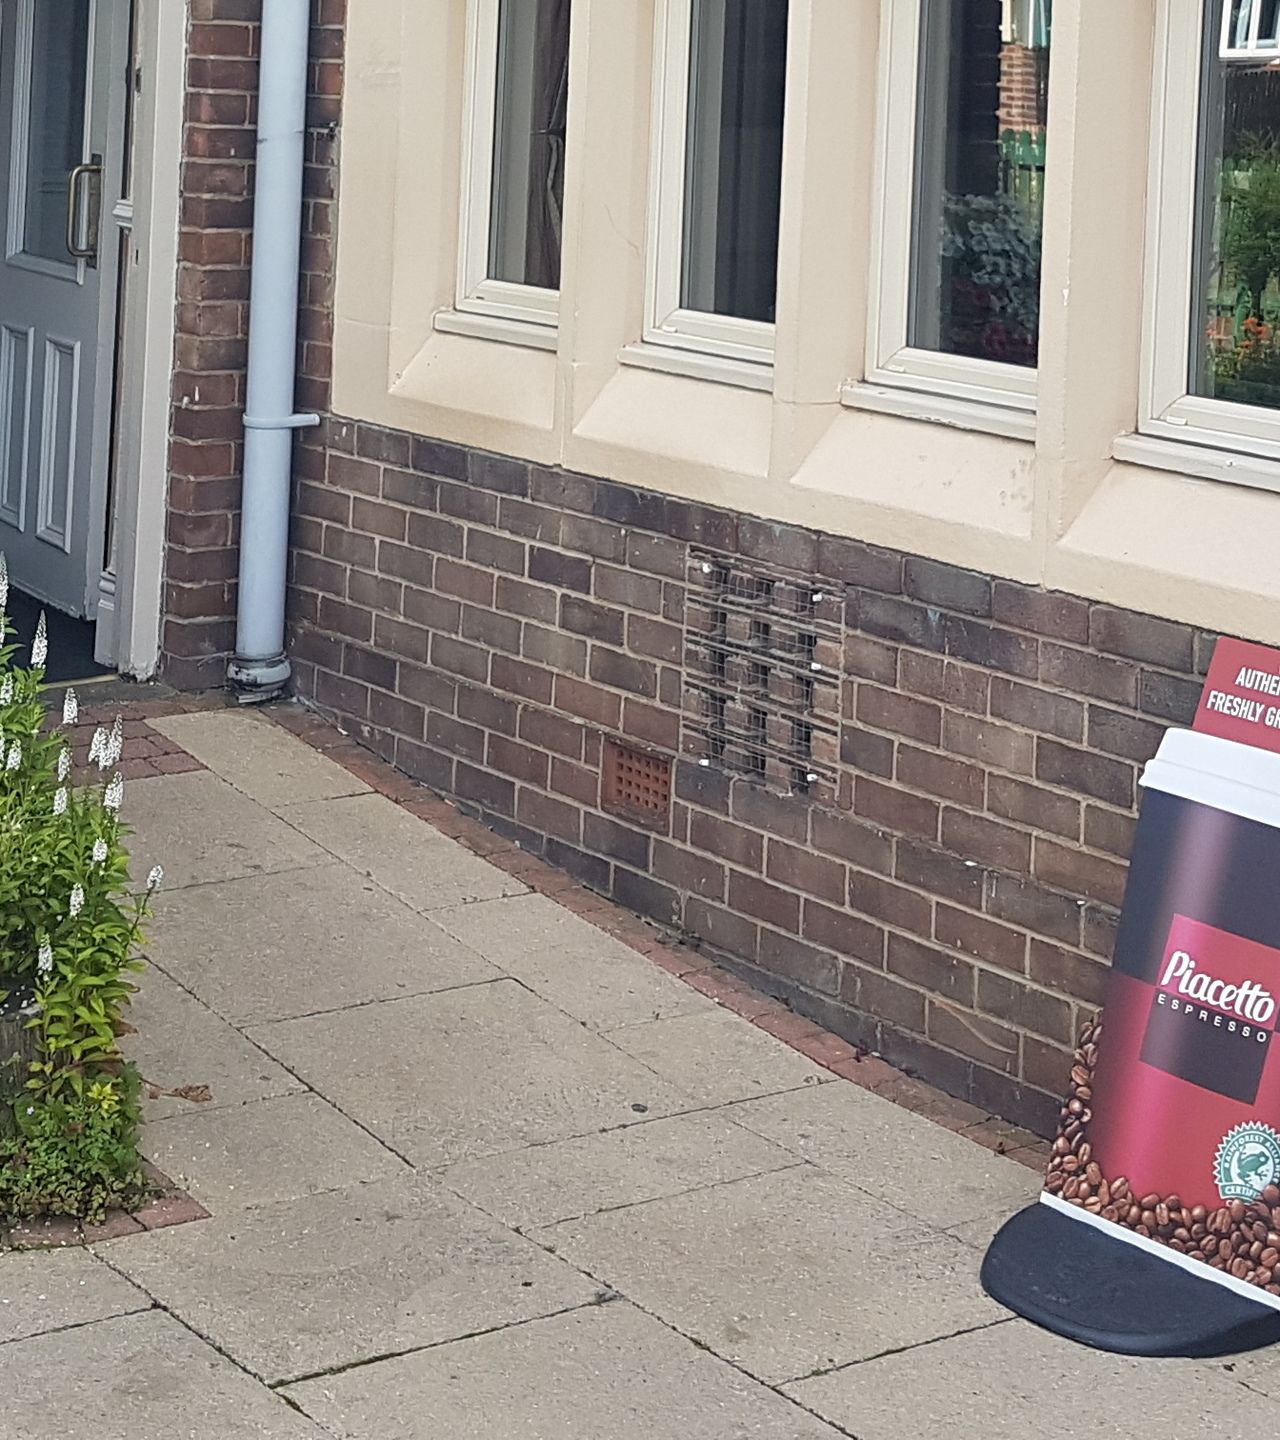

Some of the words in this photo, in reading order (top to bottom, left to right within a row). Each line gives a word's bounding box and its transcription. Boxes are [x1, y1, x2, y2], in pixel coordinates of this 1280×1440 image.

[1205, 689, 1266, 724] FRESHLY
[1160, 950, 1276, 1023] Piacetto
[1157, 993, 1268, 1043] ESPRESSO
[1223, 1134, 1265, 1169] RAINFOREST
